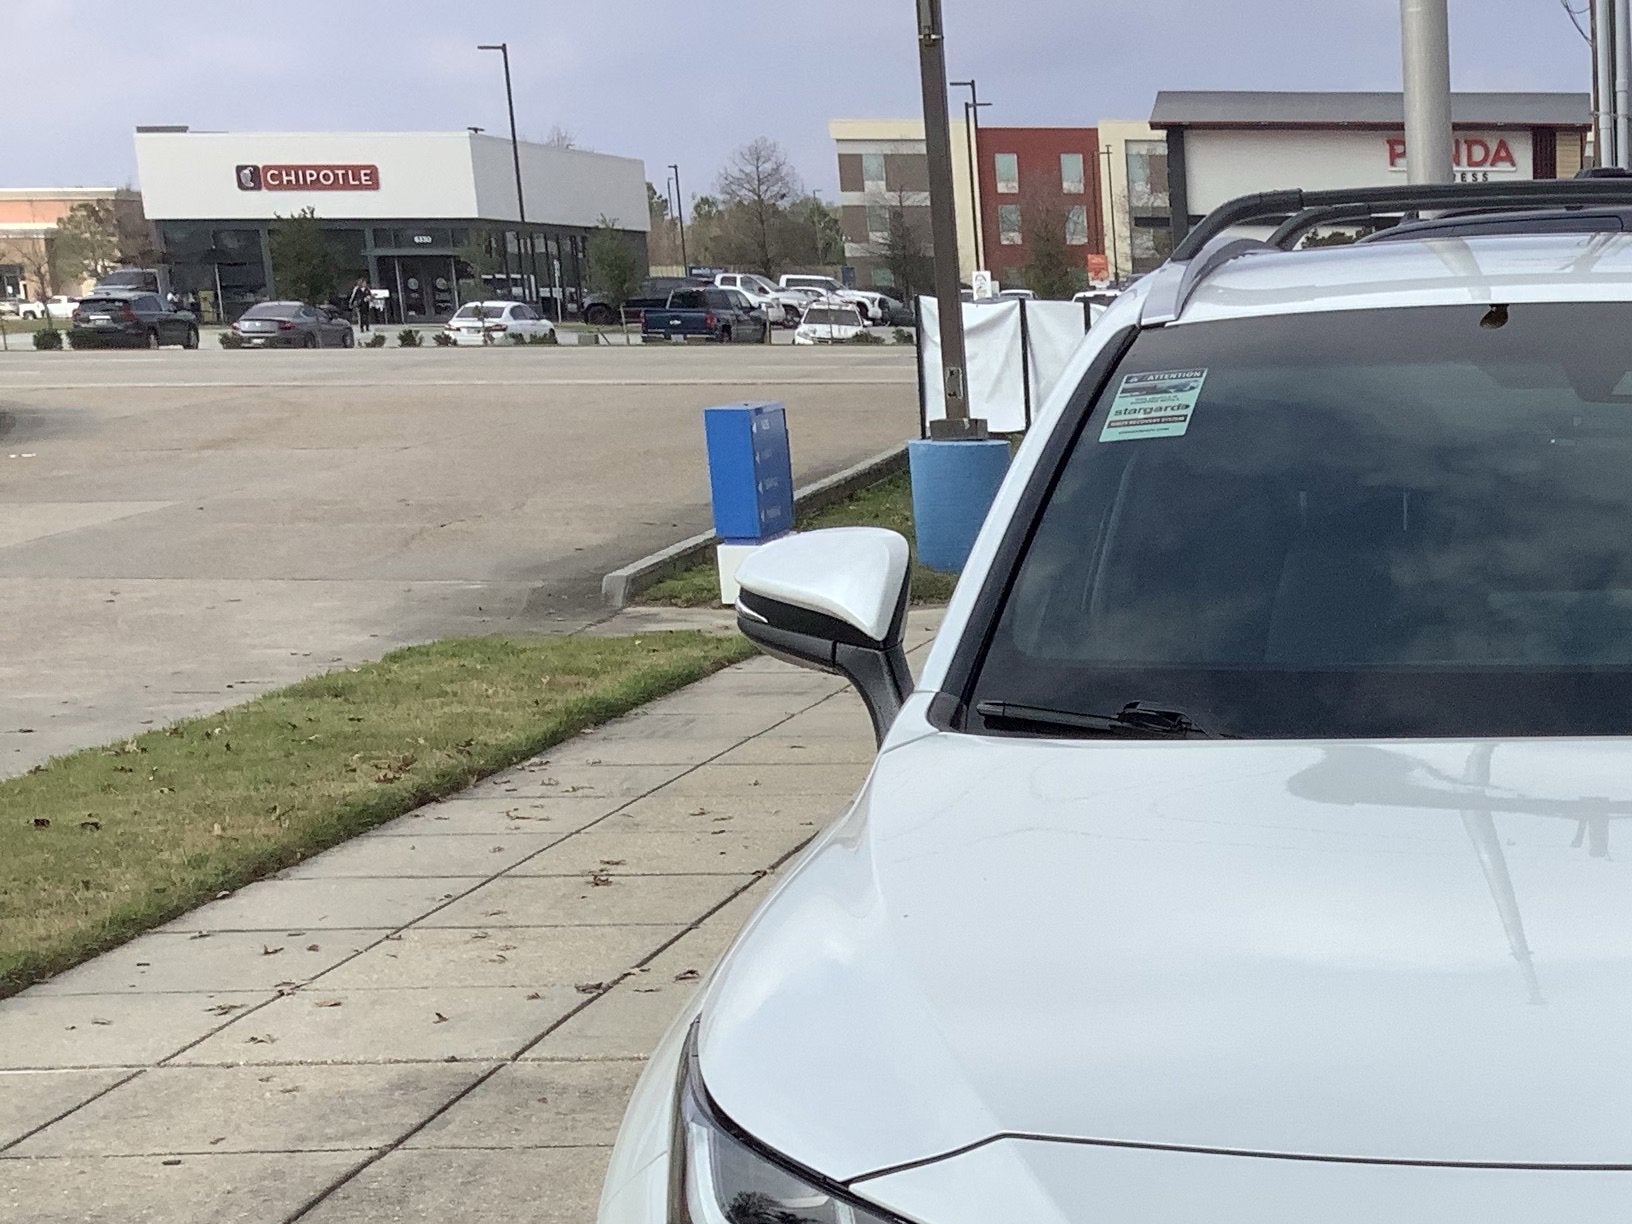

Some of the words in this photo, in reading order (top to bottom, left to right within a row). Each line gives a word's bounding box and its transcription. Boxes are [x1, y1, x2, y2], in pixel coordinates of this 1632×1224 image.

[1386, 138, 1517, 167] PDA
[266, 169, 373, 185] CHIPOTLE
[1147, 371, 1201, 381] ATTENTION
